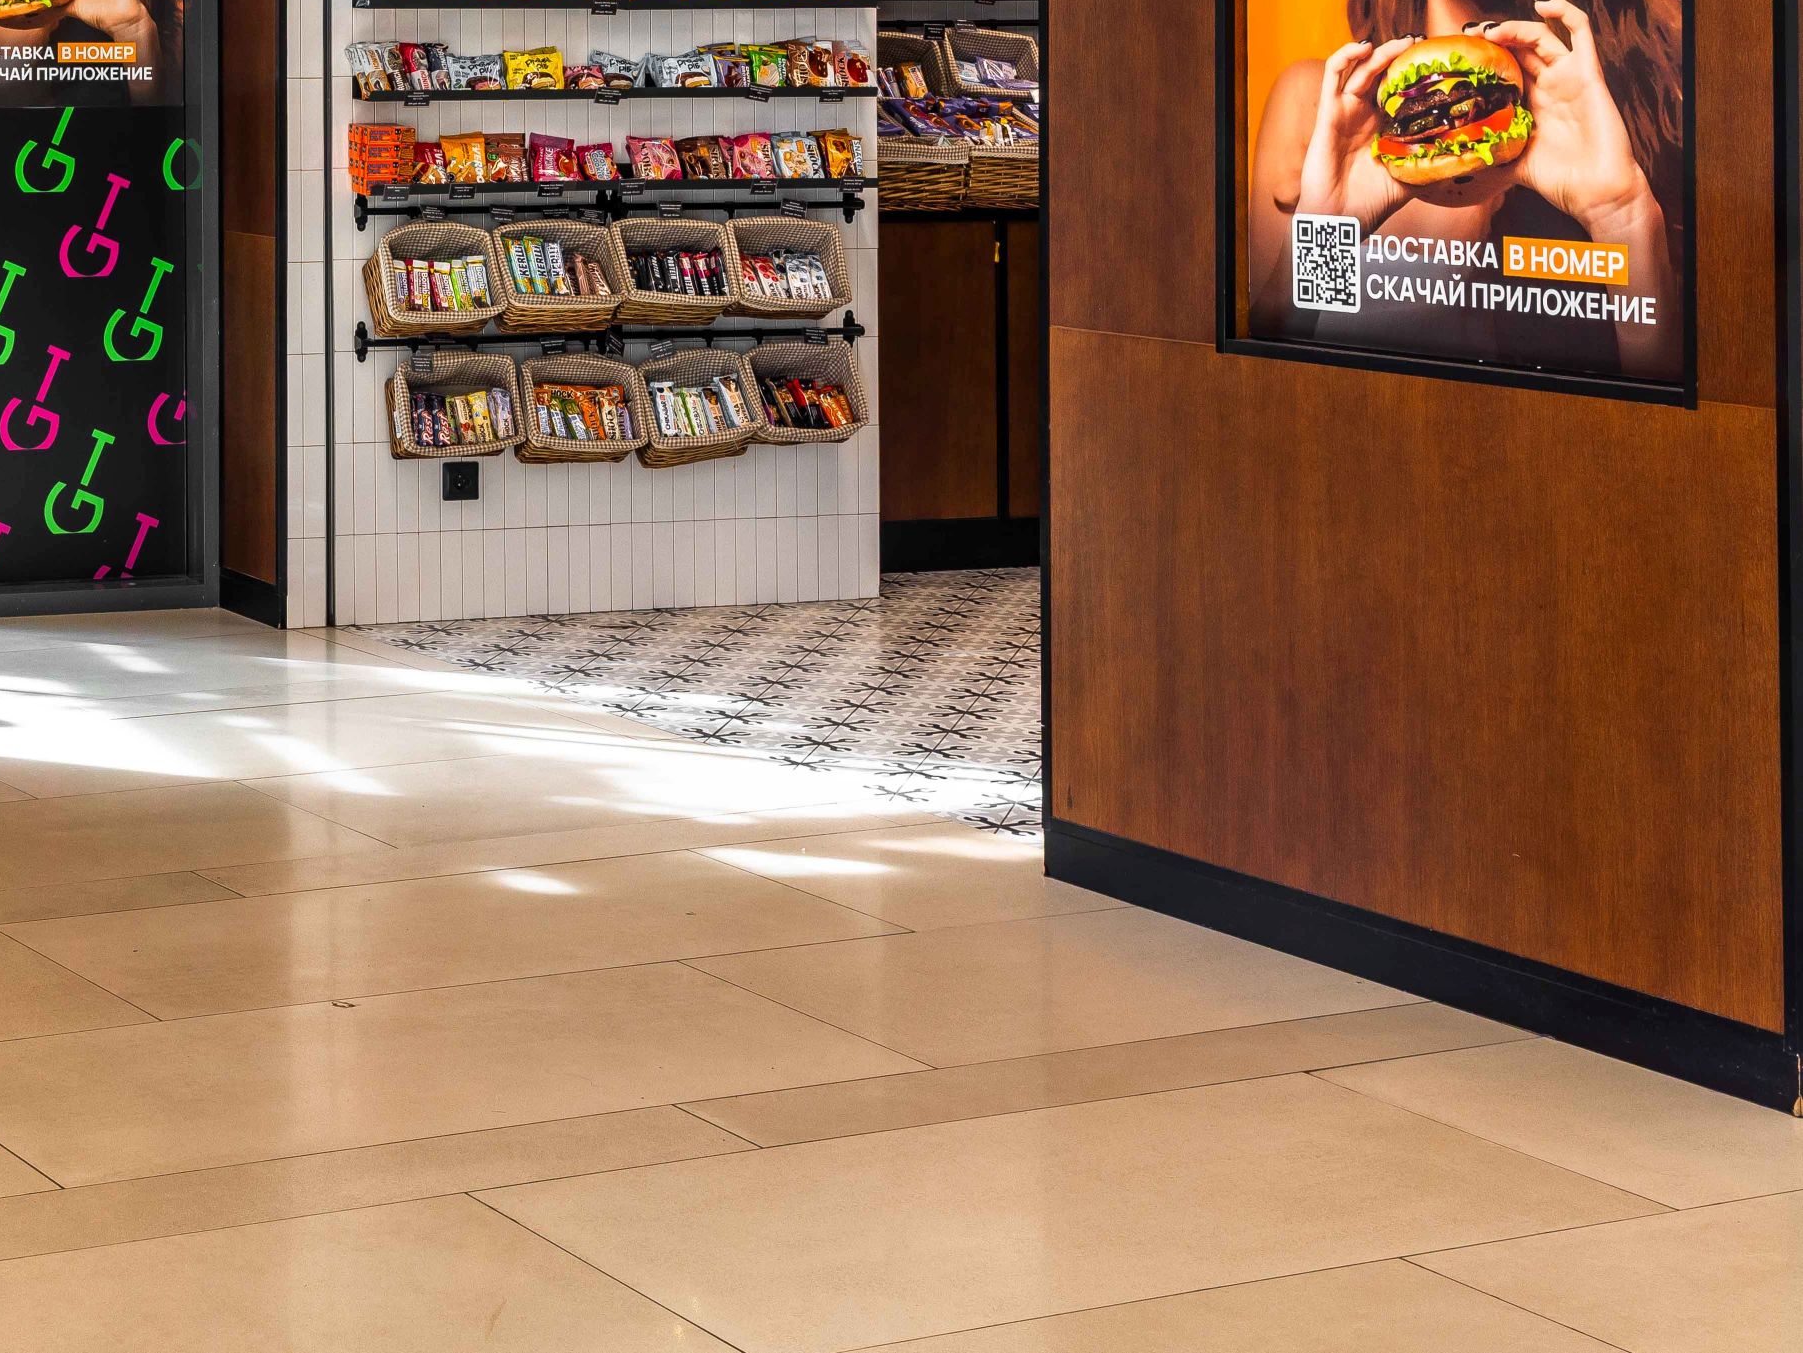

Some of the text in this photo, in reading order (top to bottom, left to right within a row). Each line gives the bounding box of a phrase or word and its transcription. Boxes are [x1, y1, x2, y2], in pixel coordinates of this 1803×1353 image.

[61, 46, 73, 60] В
[75, 46, 135, 60] НОМЕР
[36, 66, 153, 81] ПРИЛОЖЕНИЕ
[1365, 234, 1625, 279] ДОСТАВКА В НОМЕР
[1365, 273, 1658, 325] СКАЧАЙ ПРИЛОЖЕНИЕ
[550, 390, 574, 399] HOCK
